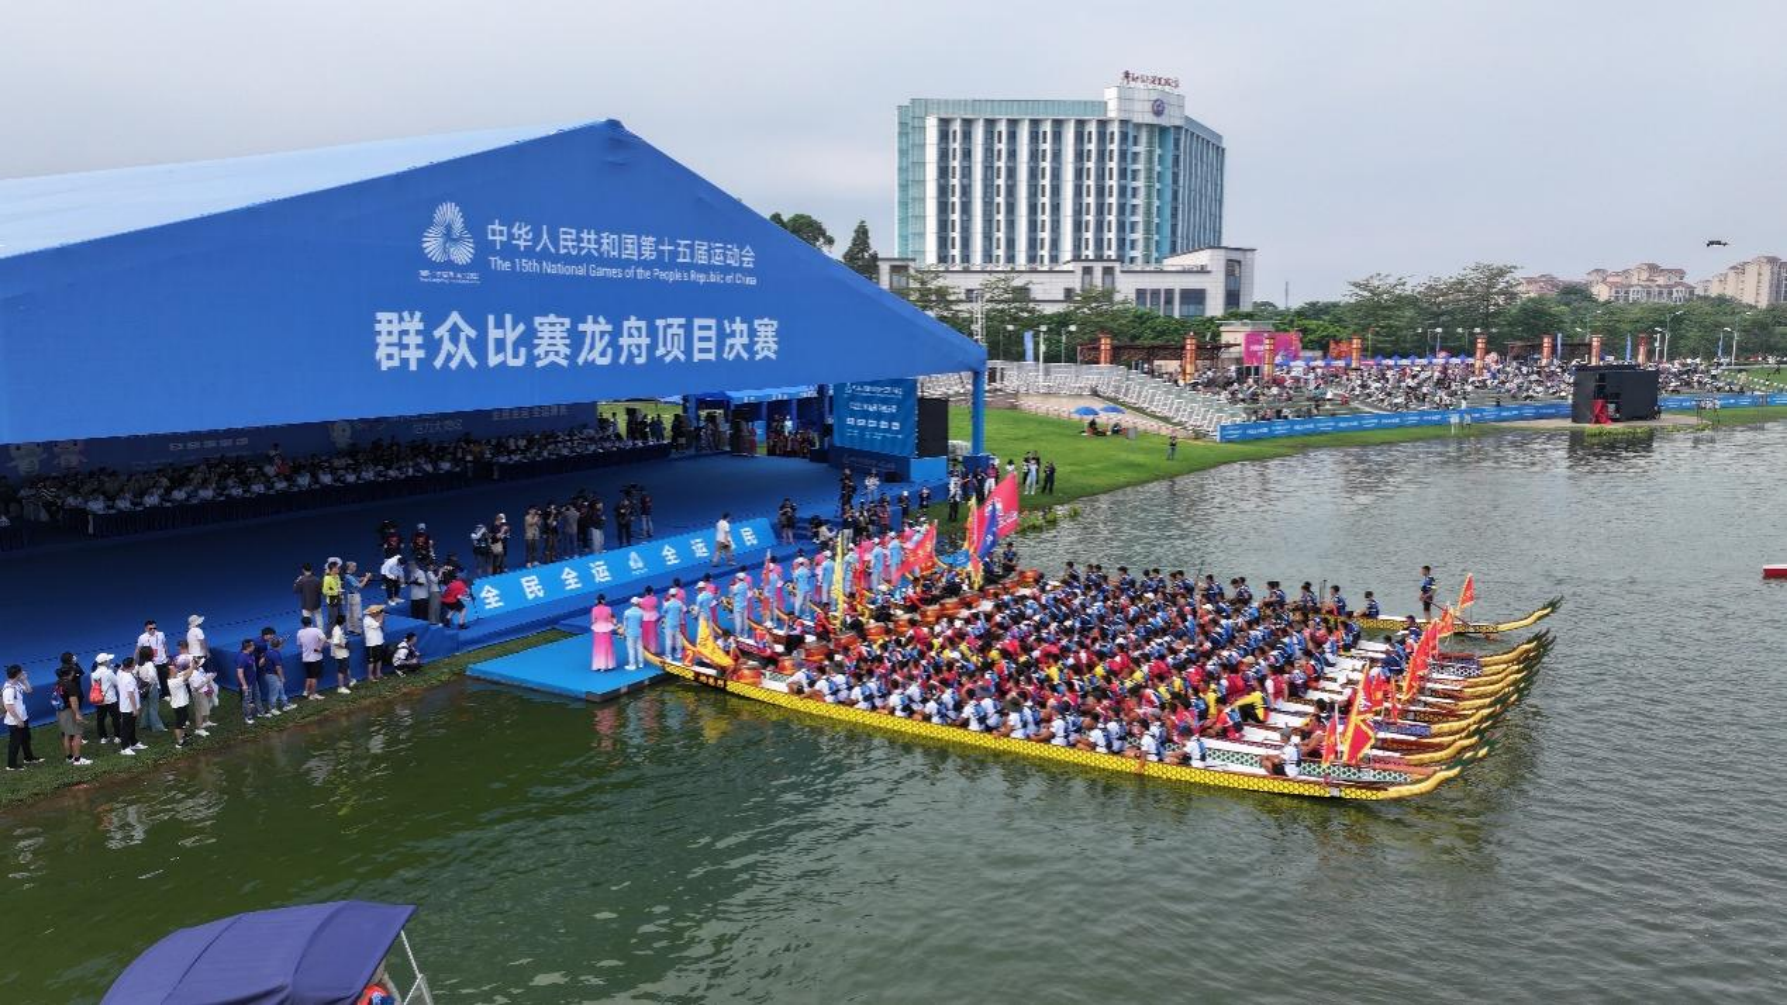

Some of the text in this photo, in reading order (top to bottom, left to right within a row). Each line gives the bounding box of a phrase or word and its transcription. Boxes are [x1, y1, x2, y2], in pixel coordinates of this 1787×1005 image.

[487, 219, 756, 269] 中华人民共和国第十五届运动会
[489, 255, 512, 271] The
[515, 258, 540, 273] 15th
[542, 261, 588, 276] National
[589, 264, 624, 279] Games
[625, 265, 635, 278] of
[636, 267, 651, 280] the
[374, 310, 779, 371] 群众比赛龙舟项目决赛
[661, 526, 759, 567] 全运民
[479, 560, 612, 610] 全民全运
